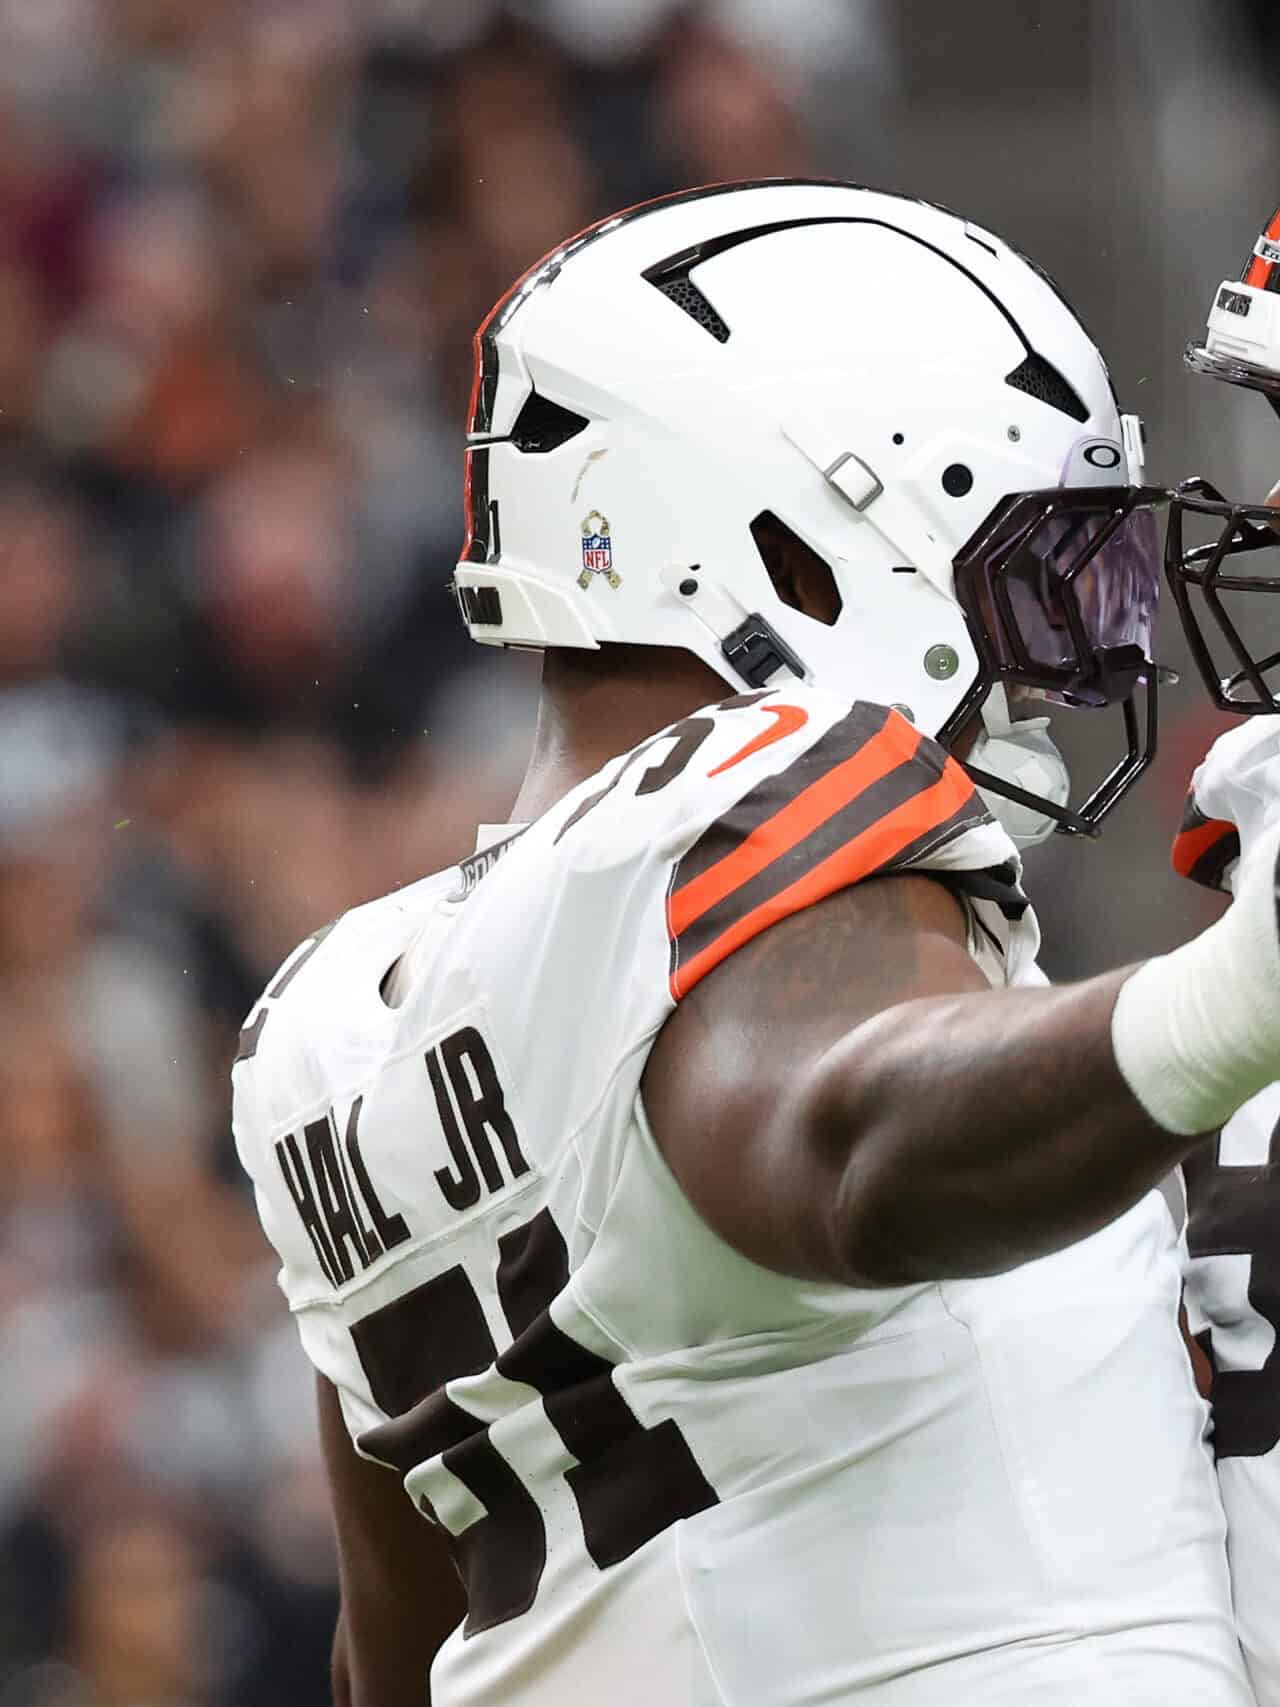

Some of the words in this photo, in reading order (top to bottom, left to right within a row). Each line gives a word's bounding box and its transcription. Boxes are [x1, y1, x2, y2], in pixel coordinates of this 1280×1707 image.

[586, 550, 609, 569] NFL
[275, 1095, 411, 1290] HALL
[423, 1025, 531, 1212] JR
[348, 1205, 722, 1641] 51
